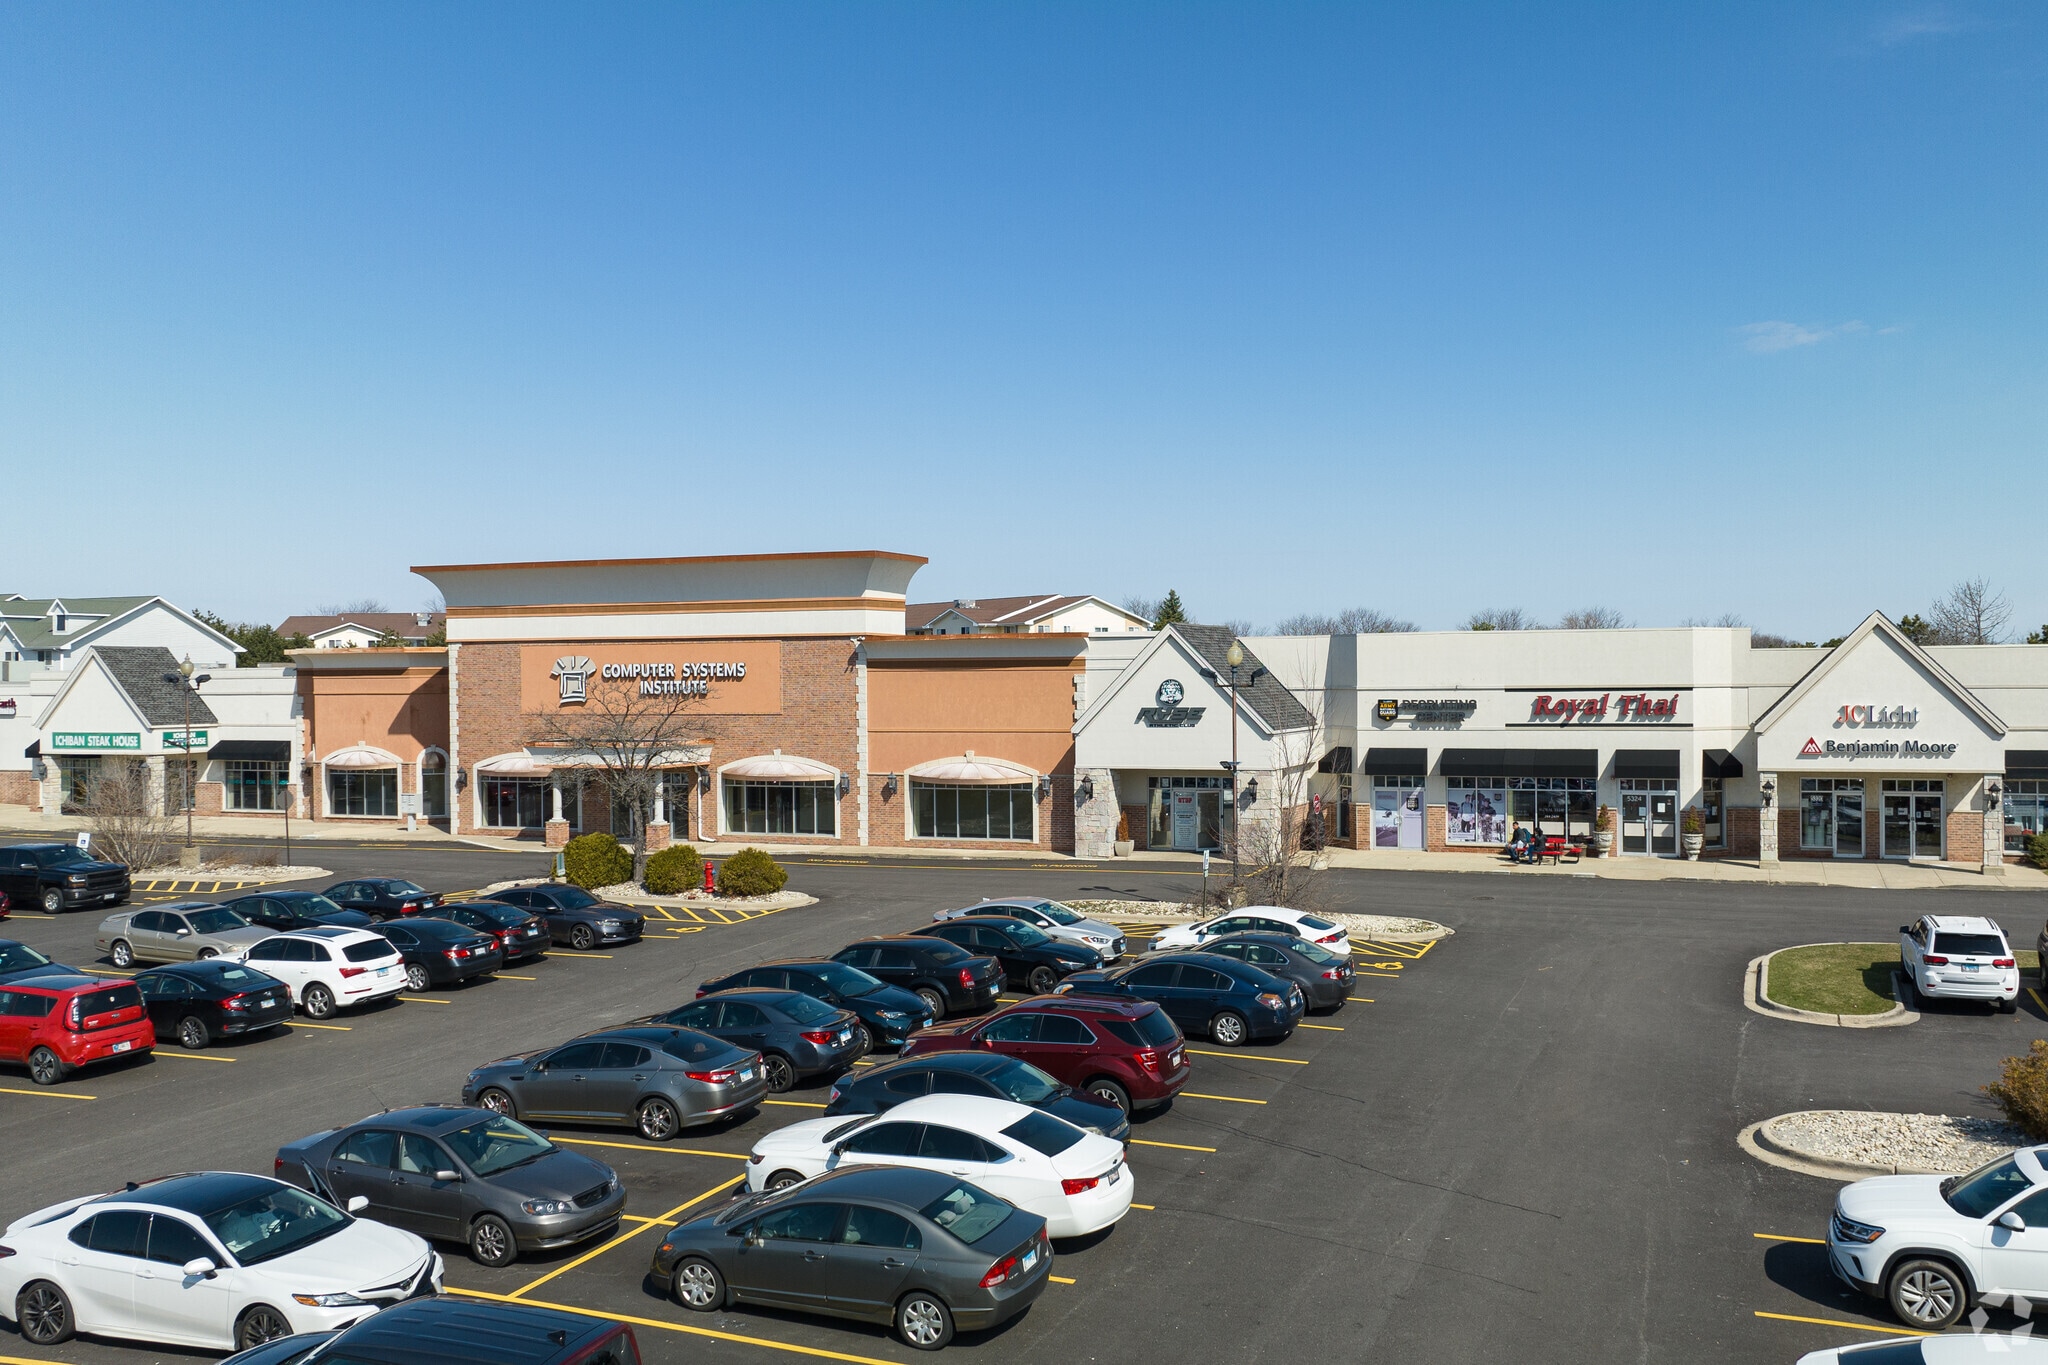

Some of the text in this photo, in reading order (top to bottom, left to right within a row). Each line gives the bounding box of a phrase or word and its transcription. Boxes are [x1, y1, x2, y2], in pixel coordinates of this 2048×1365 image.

[602, 662, 746, 678] COMPUTER SYSTEMS
[640, 680, 707, 695] INSTITUTE
[1402, 700, 1477, 710] RECRUITING
[1534, 693, 1679, 721] Royal Thai
[1416, 712, 1465, 722] CENTER
[55, 736, 138, 746] ICHIBAN STEAK HOUSE
[1826, 740, 1956, 755] Benjamin Moore
